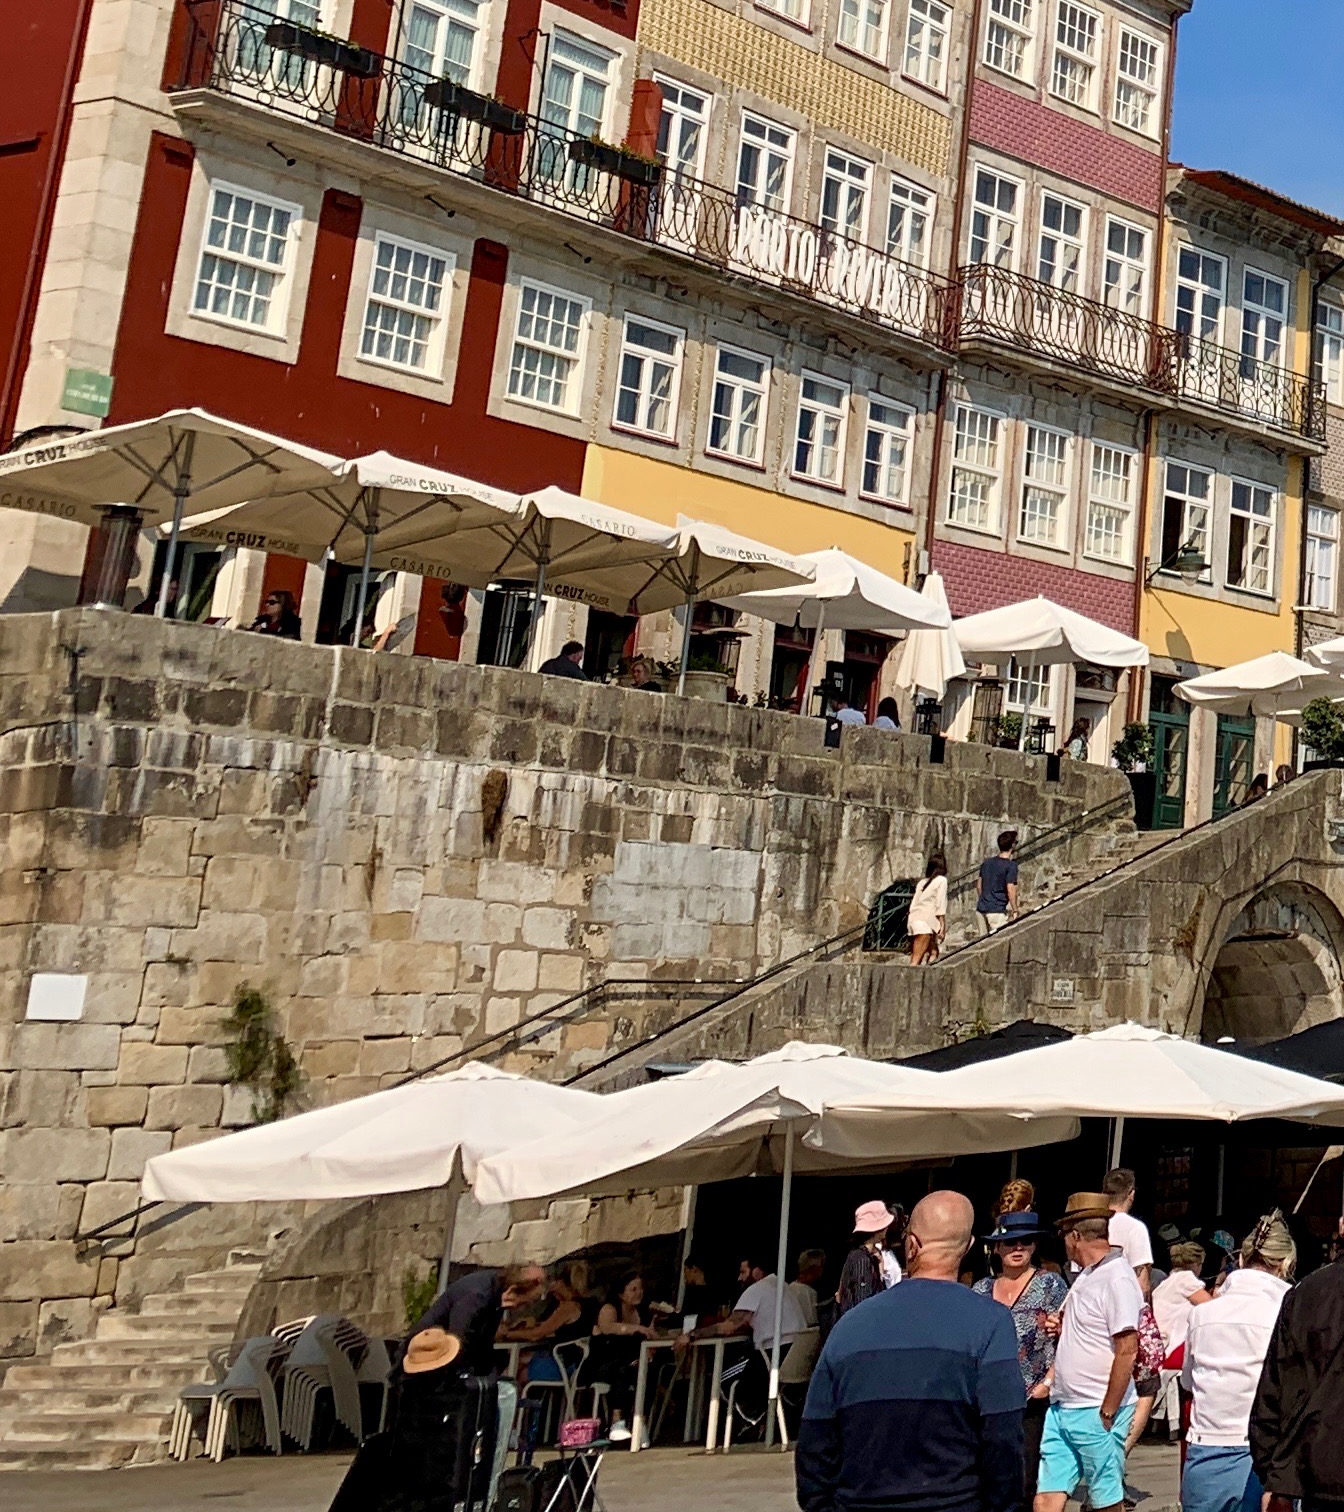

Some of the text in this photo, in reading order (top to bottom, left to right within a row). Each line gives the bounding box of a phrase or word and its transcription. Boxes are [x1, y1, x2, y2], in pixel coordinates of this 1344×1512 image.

[0, 456, 21, 470] RAN
[24, 445, 67, 466] CRUZ
[389, 474, 416, 488] GRAN
[419, 478, 456, 494] CRUZ
[1, 492, 77, 518] CASARIO
[190, 526, 223, 541] GRAN
[226, 530, 267, 548] CRUZ
[581, 514, 636, 537] CASARIO
[737, 548, 770, 562] CRUZ
[389, 556, 452, 579] CASARIO
[554, 583, 584, 601] CRUZ
[585, 591, 610, 608] HOUSE
